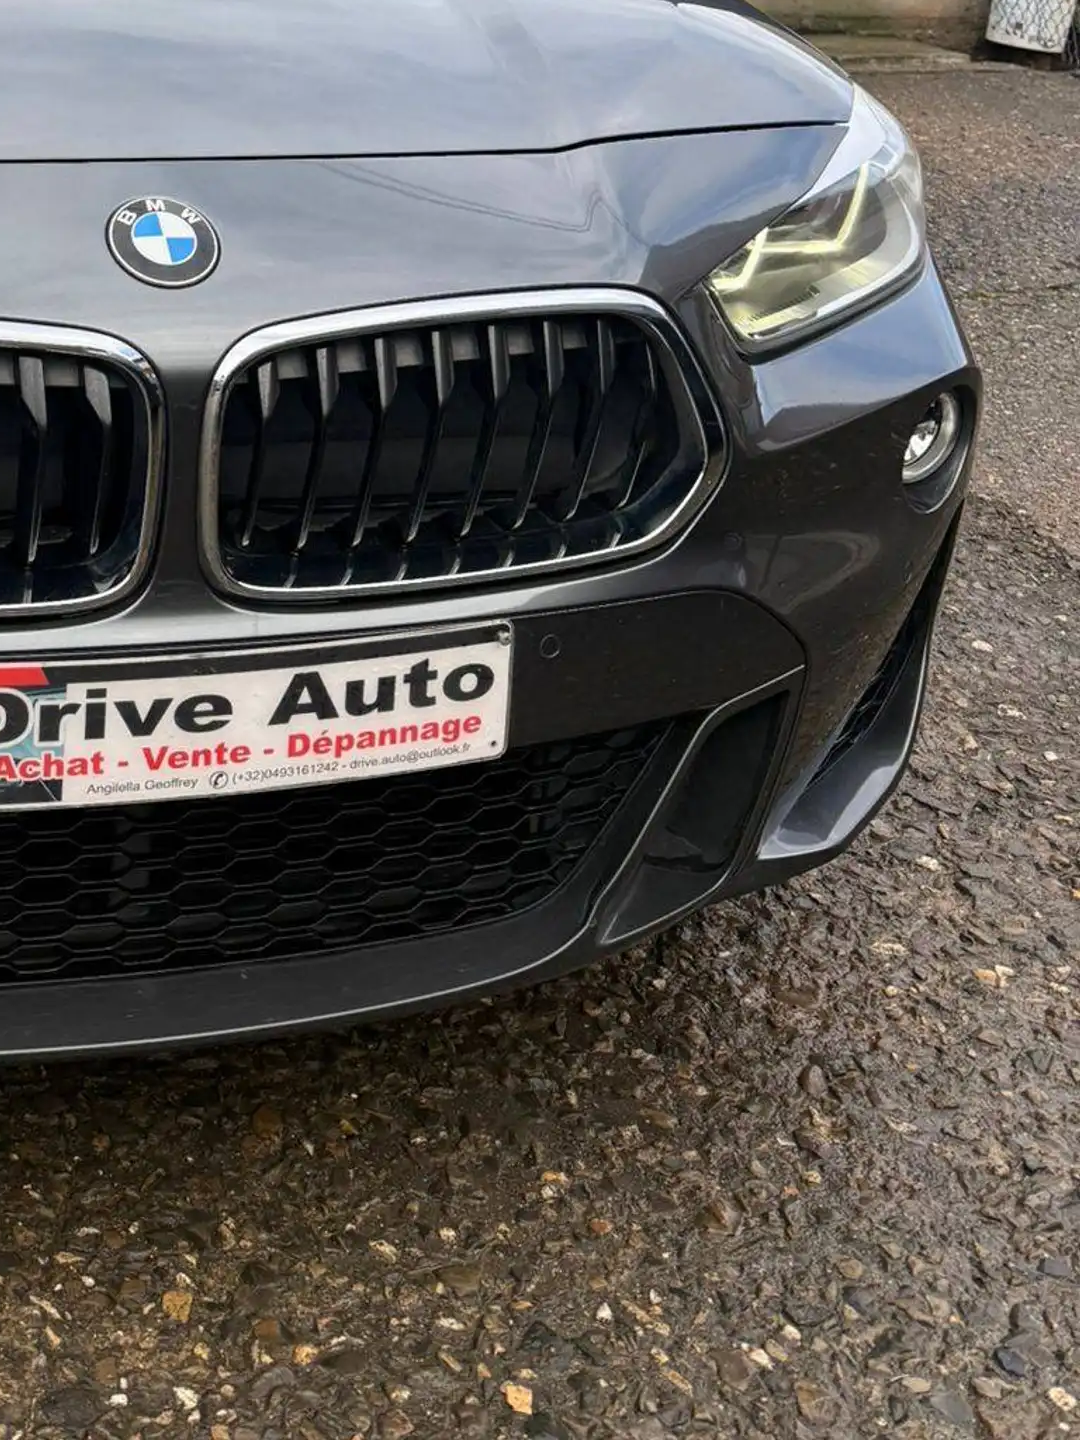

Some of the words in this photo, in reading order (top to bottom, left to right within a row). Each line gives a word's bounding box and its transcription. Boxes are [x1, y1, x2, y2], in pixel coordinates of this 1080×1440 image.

[117, 198, 201, 226] BMW
[267, 657, 496, 727] Auto
[142, 741, 252, 772] Vente
[287, 714, 483, 759] Dépannage
[144, 776, 200, 793] Geoffrey
